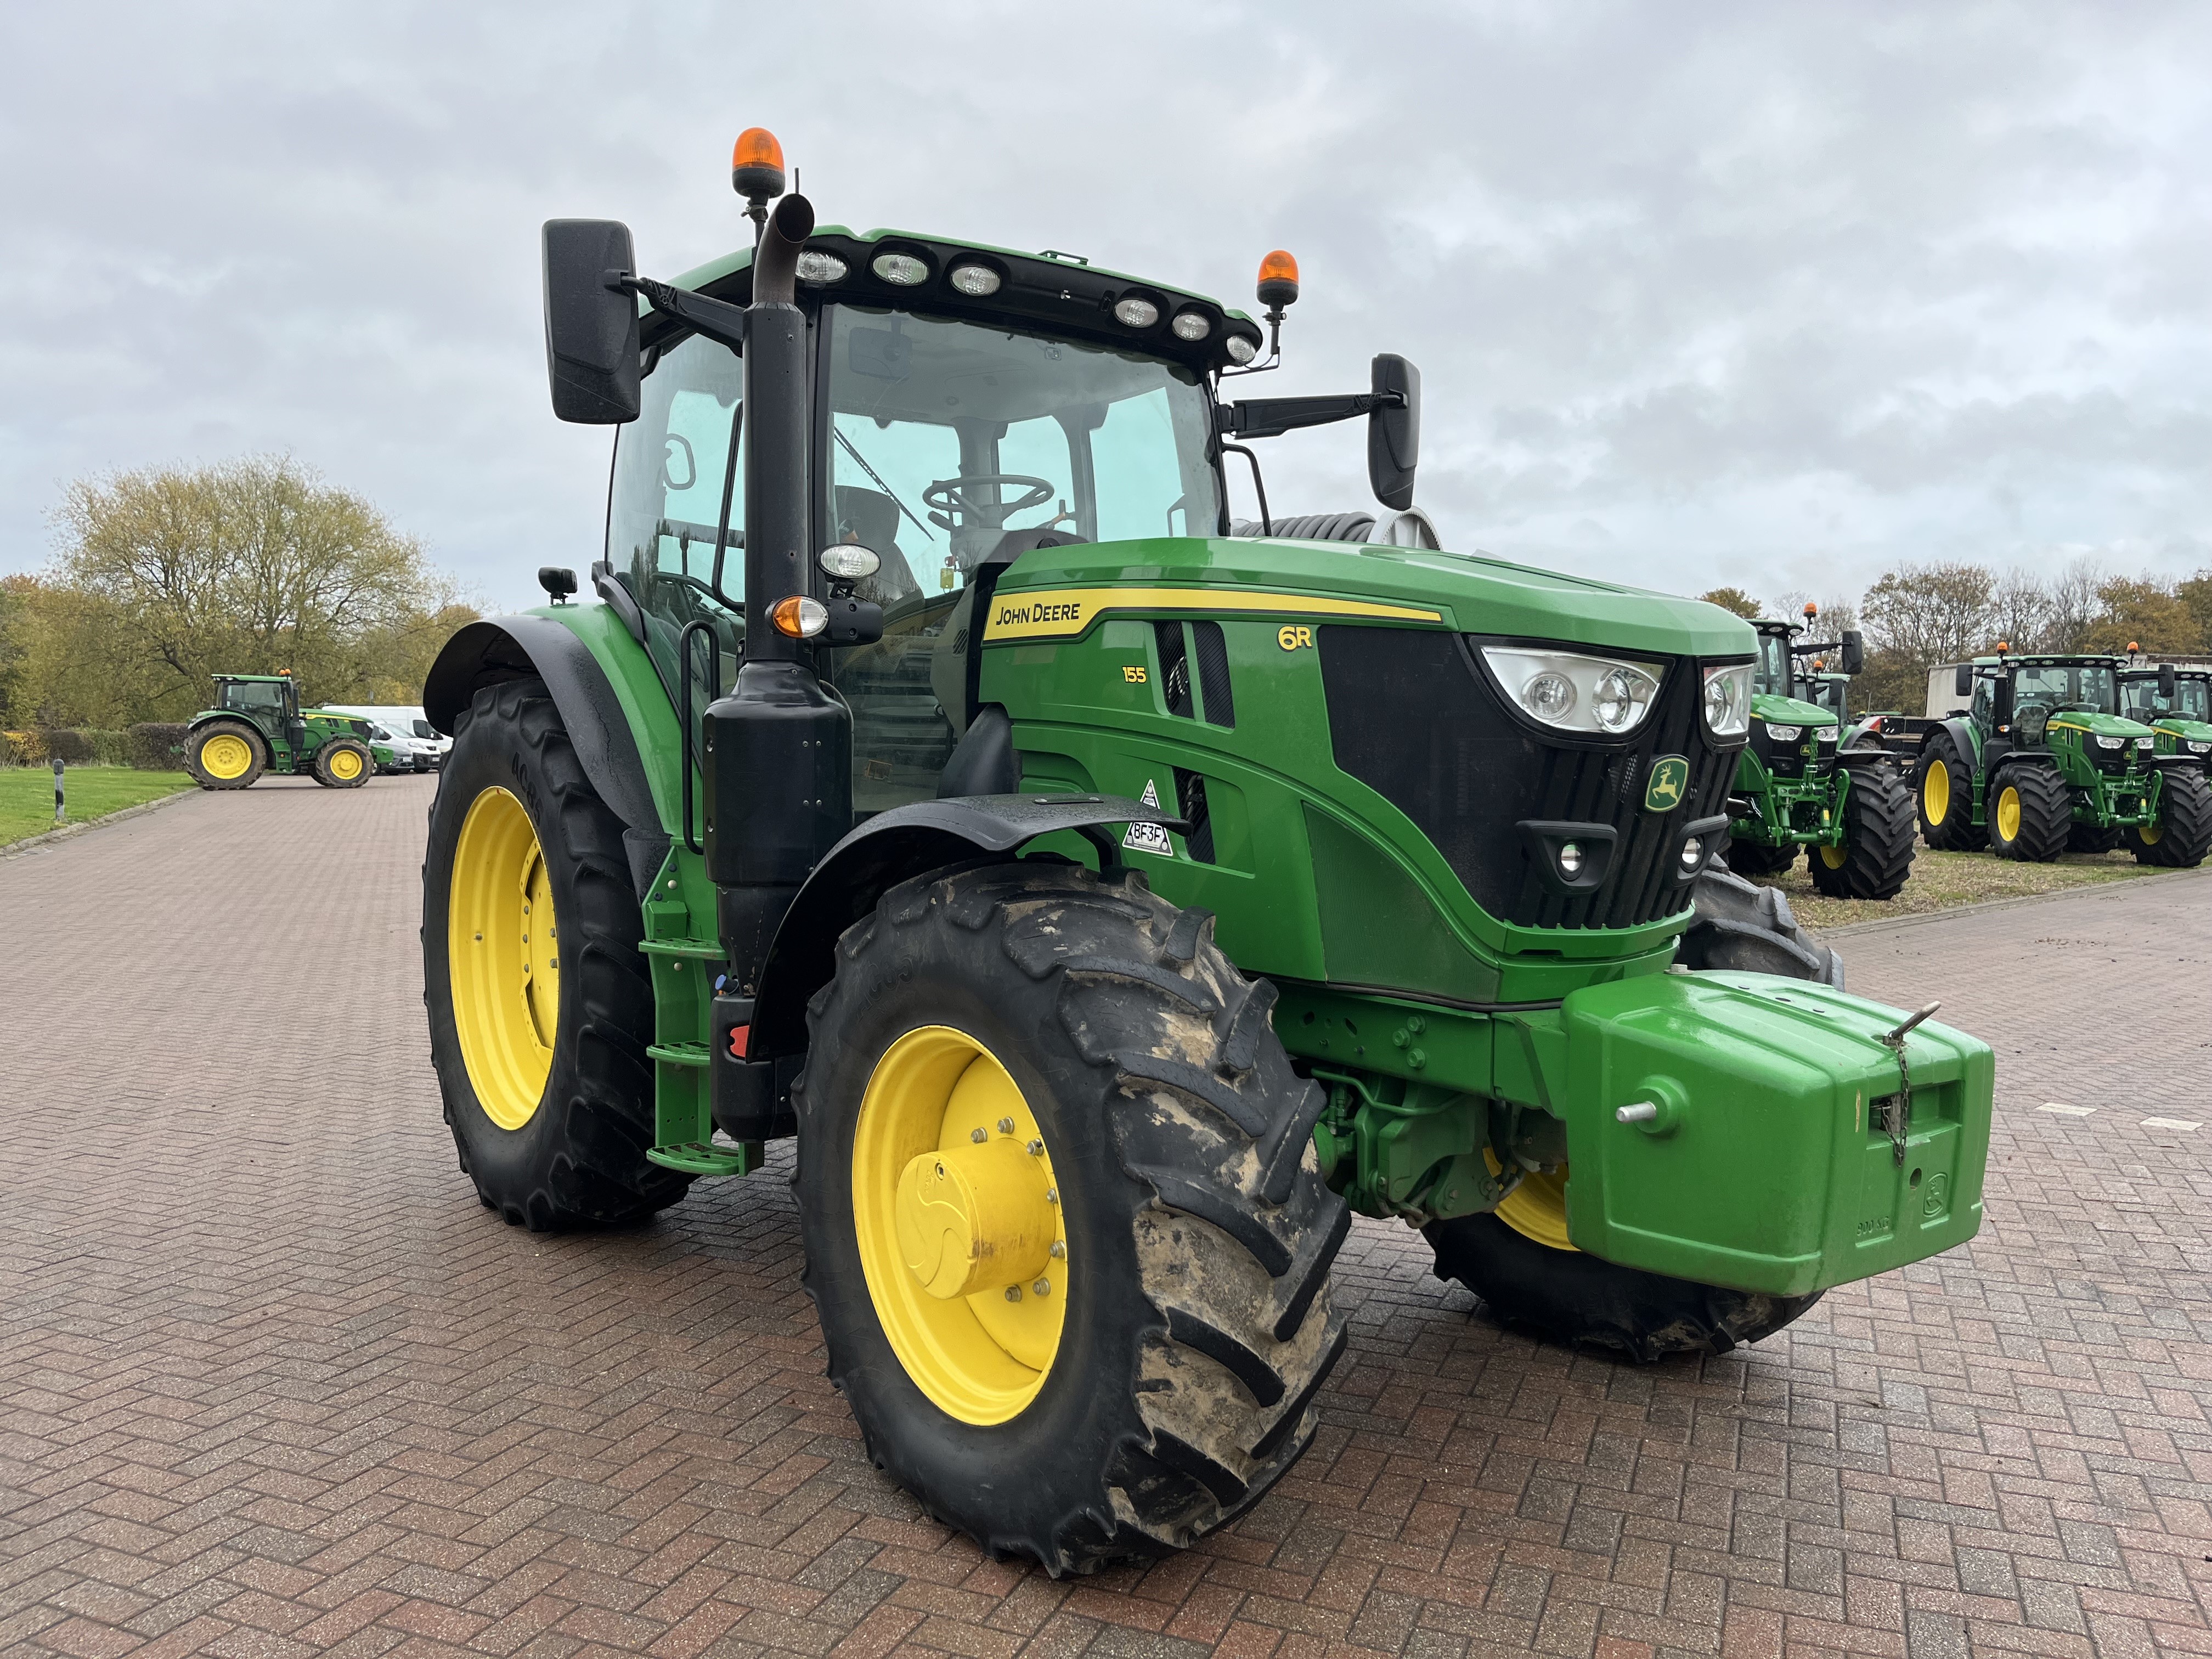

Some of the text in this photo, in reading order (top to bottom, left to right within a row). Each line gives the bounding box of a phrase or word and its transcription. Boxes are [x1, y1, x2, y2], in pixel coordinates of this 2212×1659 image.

[996, 603, 1081, 625] JOHN DEERE
[1278, 626, 1312, 652] 6R
[1122, 665, 1147, 684] 155
[512, 752, 544, 827] AC85
[1134, 822, 1161, 842] BF3F
[1857, 1220, 1874, 1236] 900
